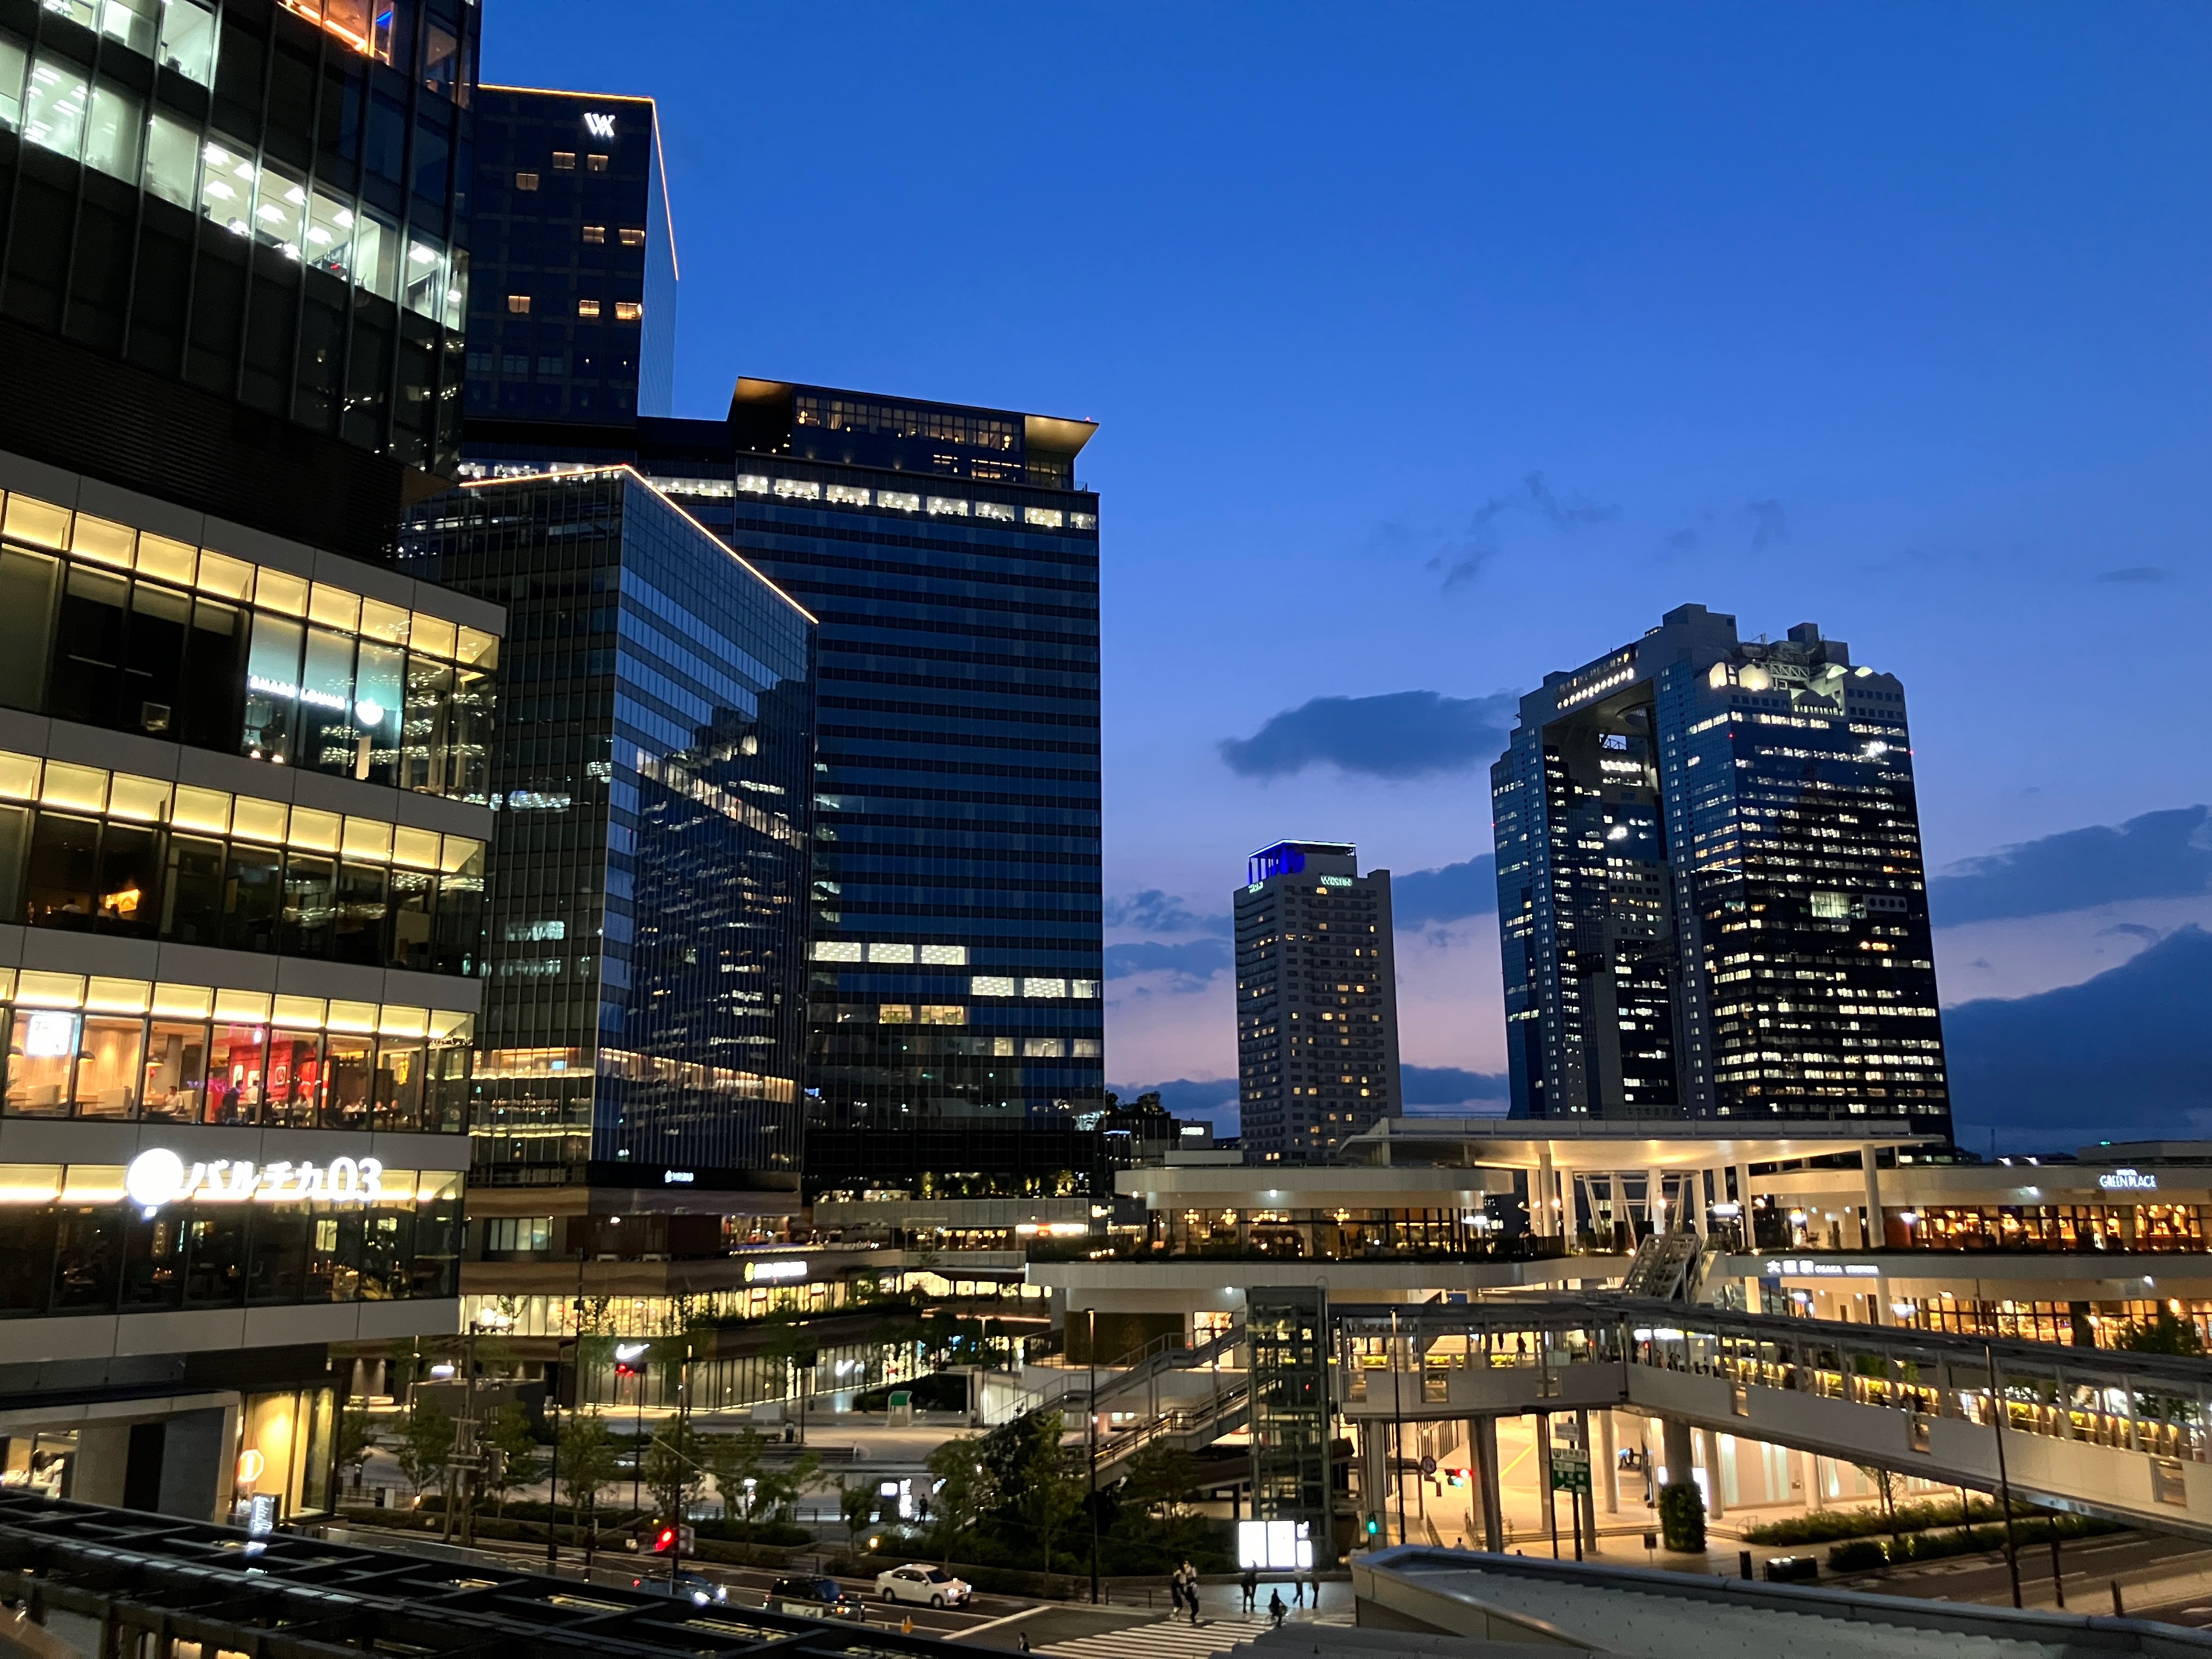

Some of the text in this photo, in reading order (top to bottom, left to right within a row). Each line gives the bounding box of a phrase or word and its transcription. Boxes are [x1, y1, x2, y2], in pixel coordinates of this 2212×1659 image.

[179, 1156, 383, 1201] バルチカ03
[2099, 1174, 2157, 1188] GREEN PLACE
